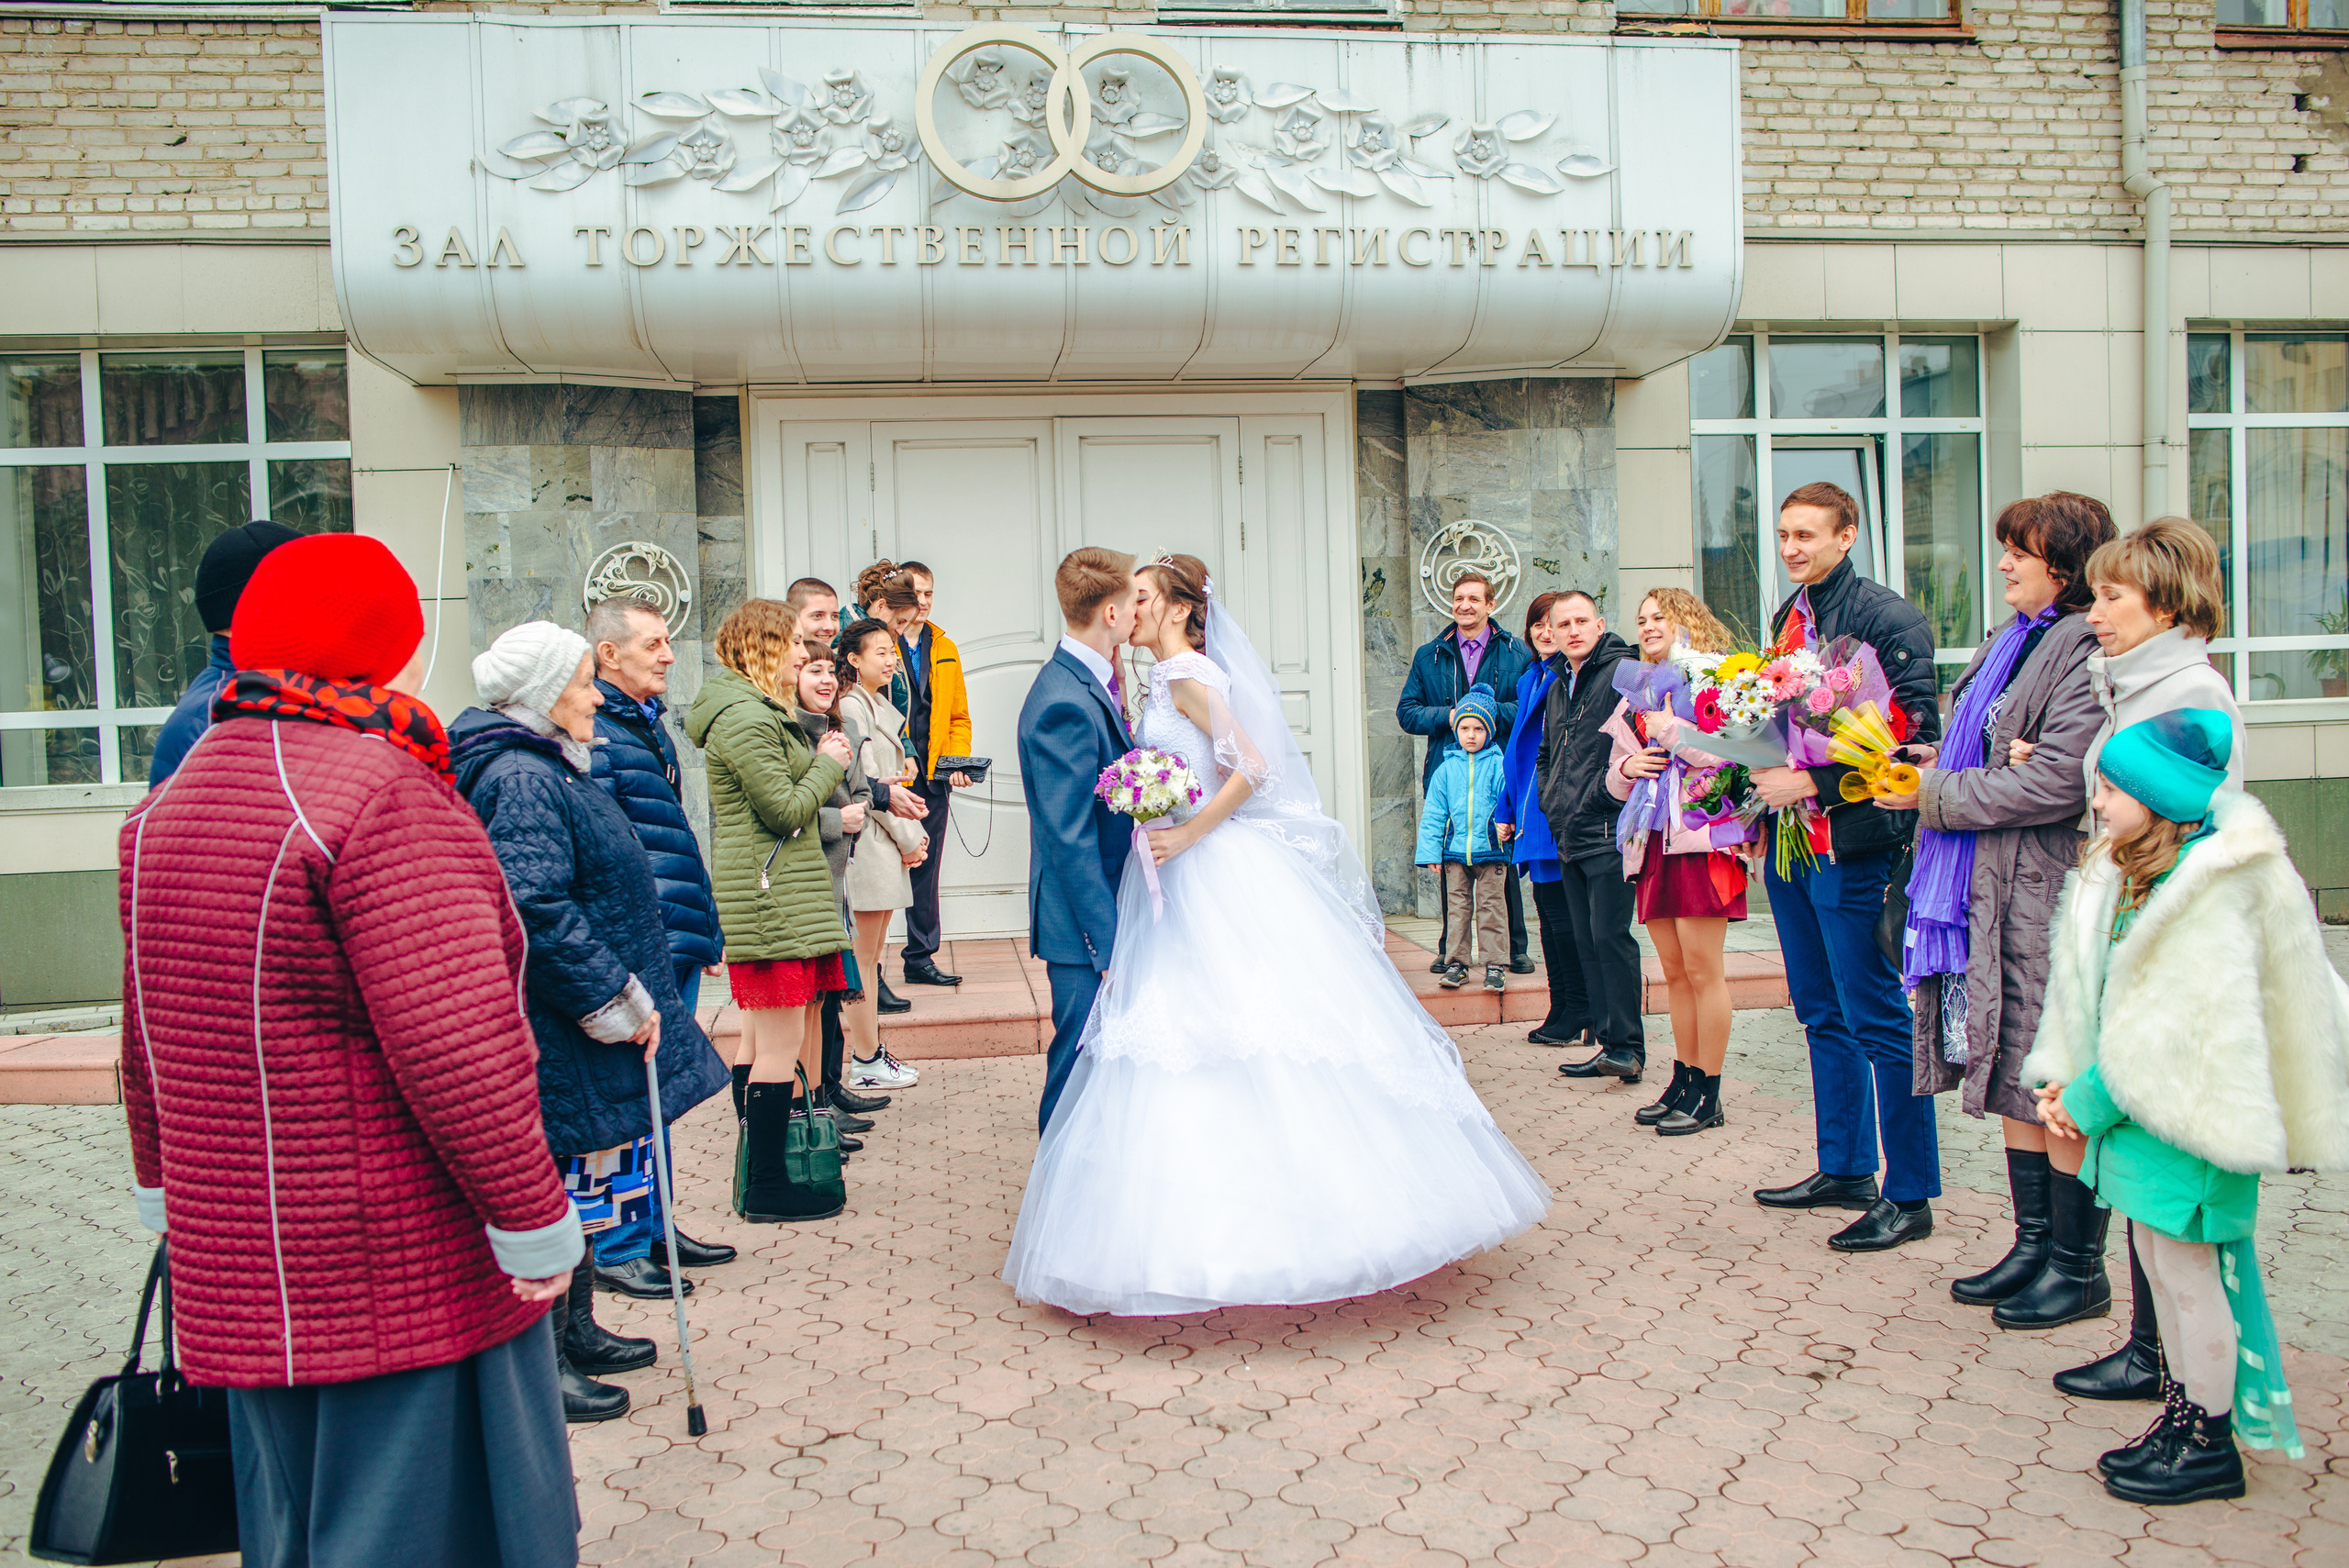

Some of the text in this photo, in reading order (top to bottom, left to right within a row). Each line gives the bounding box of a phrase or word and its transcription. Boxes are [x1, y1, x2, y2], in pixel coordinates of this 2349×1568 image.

[392, 217, 1694, 276] ЗАЛ ТОРЖЕСТВЕННОЙ РЕГИСТРАЦИИ
